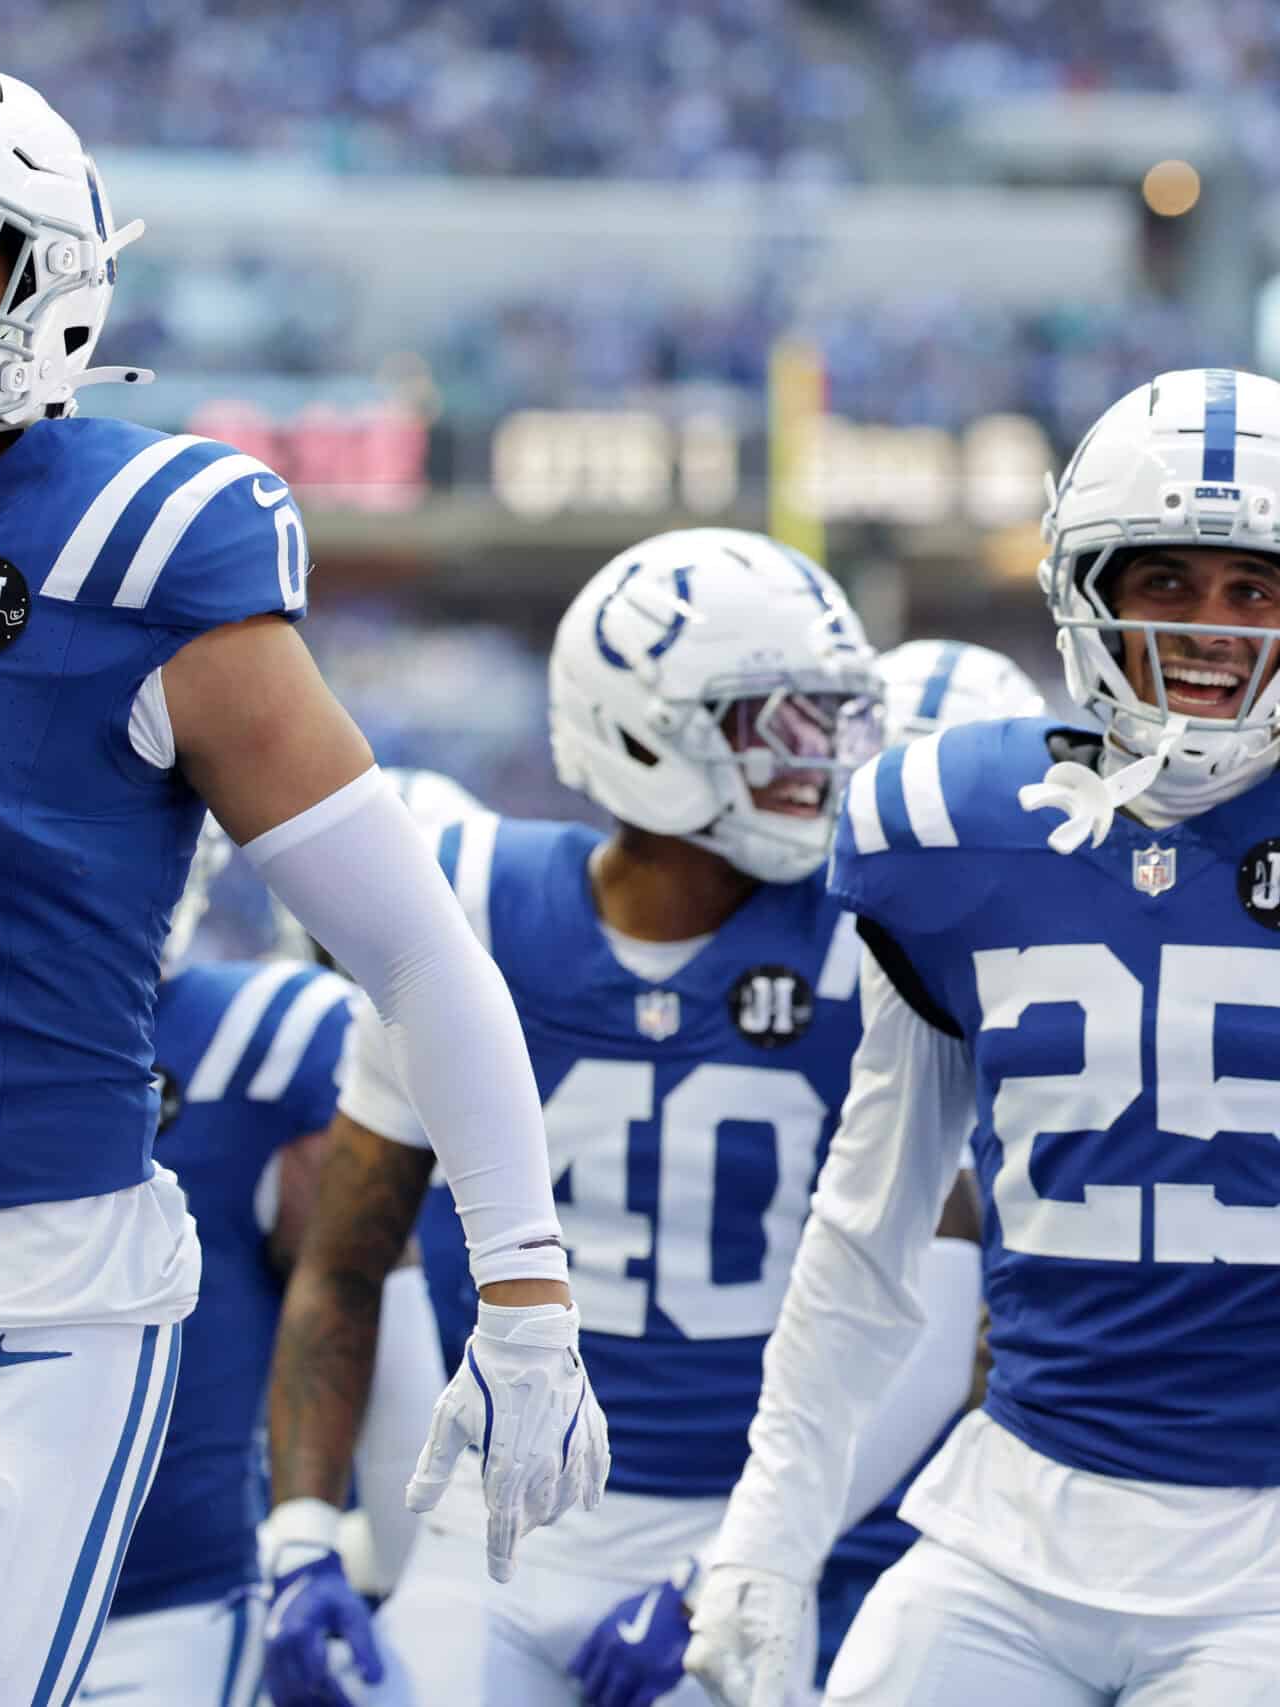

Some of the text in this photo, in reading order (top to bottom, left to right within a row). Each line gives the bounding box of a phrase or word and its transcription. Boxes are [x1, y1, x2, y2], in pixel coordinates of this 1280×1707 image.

[274, 504, 306, 612] 0
[542, 1058, 827, 1341] 40
[973, 943, 1280, 1265] 25
